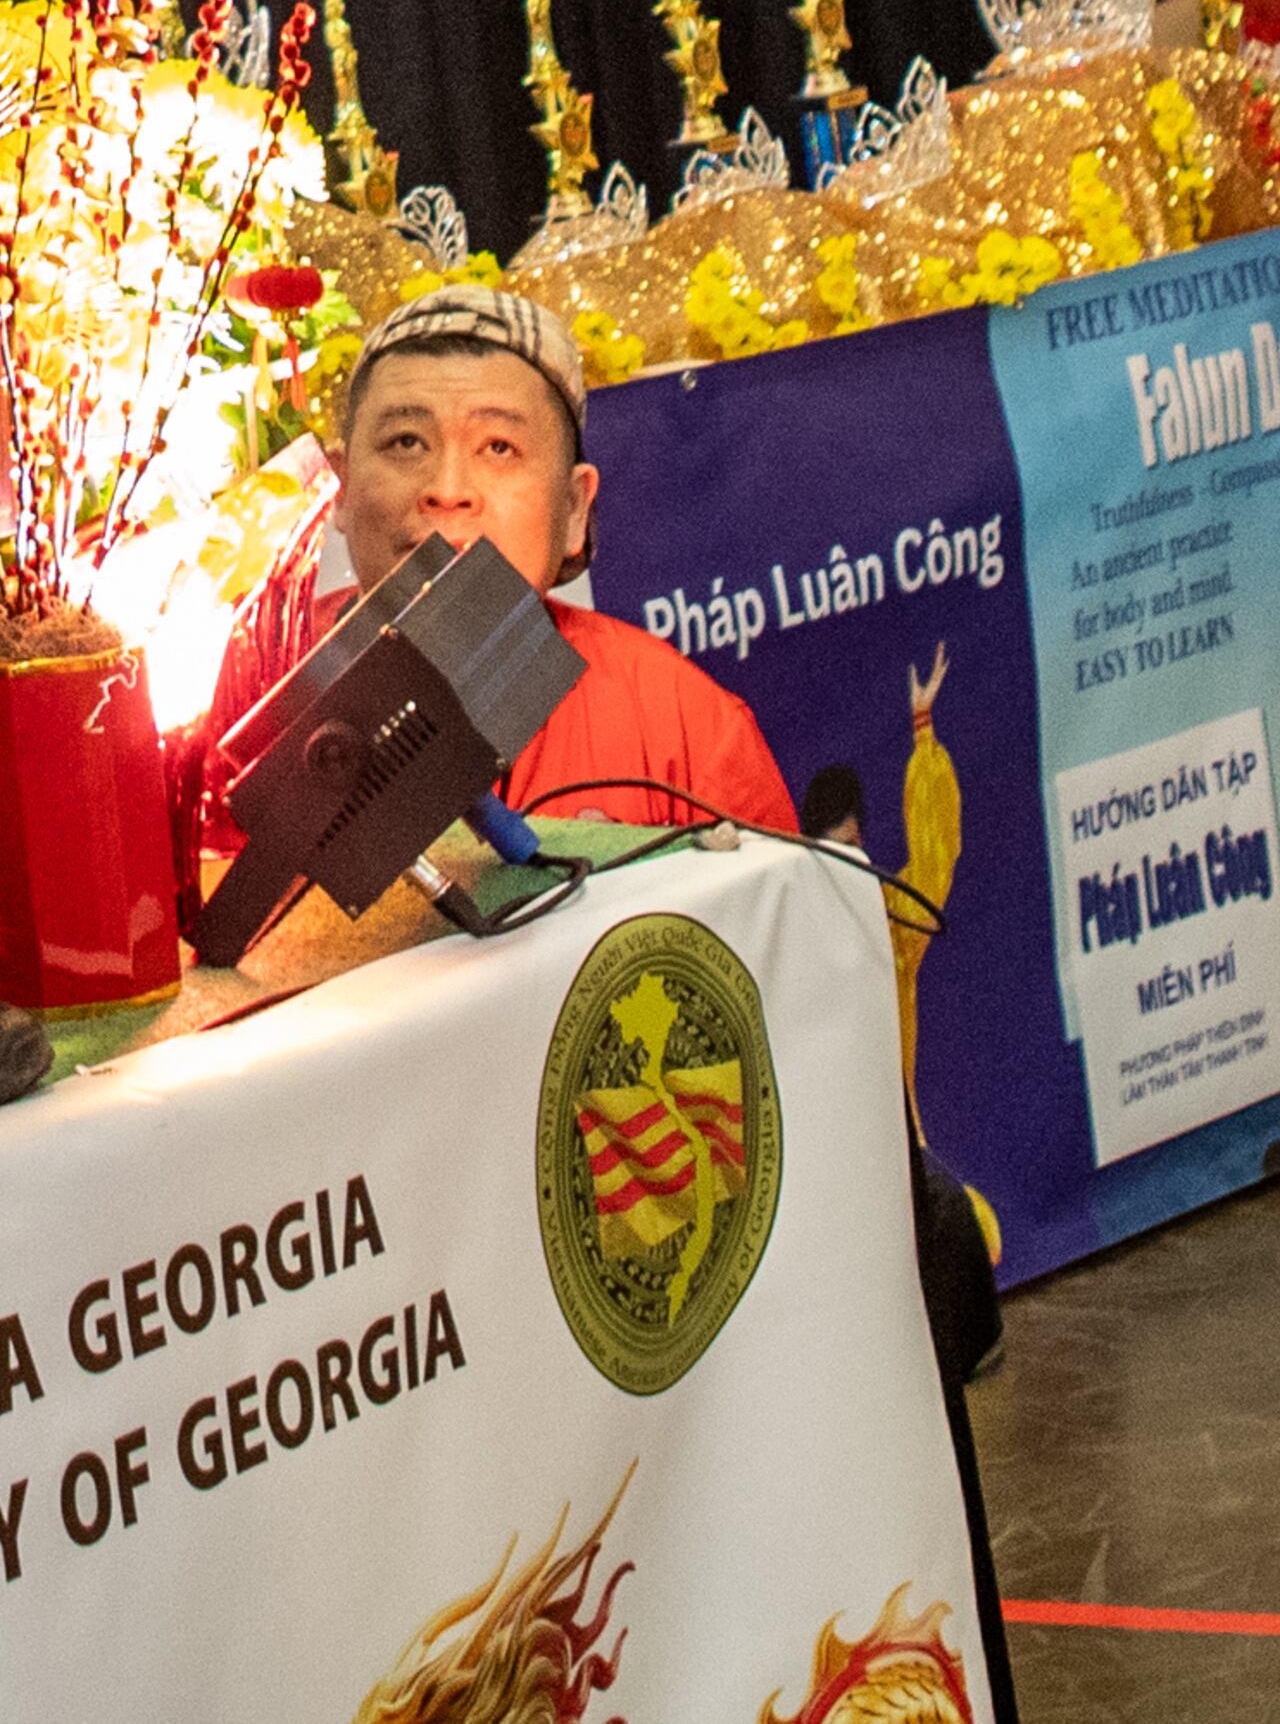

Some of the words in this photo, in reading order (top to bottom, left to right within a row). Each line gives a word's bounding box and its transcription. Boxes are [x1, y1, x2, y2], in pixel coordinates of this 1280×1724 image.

[1046, 292, 1124, 351] FREE
[1126, 342, 1253, 469] Falun
[643, 576, 766, 661] Pháp
[771, 543, 885, 630] Luân
[894, 513, 1005, 593] Công
[1071, 561, 1099, 592] An
[1073, 608, 1099, 641] for
[1104, 592, 1146, 634] body
[1151, 577, 1186, 617] and
[1075, 647, 1128, 692] EASY
[1134, 635, 1165, 674] TO
[1169, 613, 1235, 664] LEARN
[1071, 785, 1156, 842] HƯỚNG
[1198, 939, 1237, 993] PHÍ
[68, 1174, 385, 1375] GEORGIA
[61, 1427, 149, 1547] OF
[177, 1288, 466, 1491] GEORGIA
